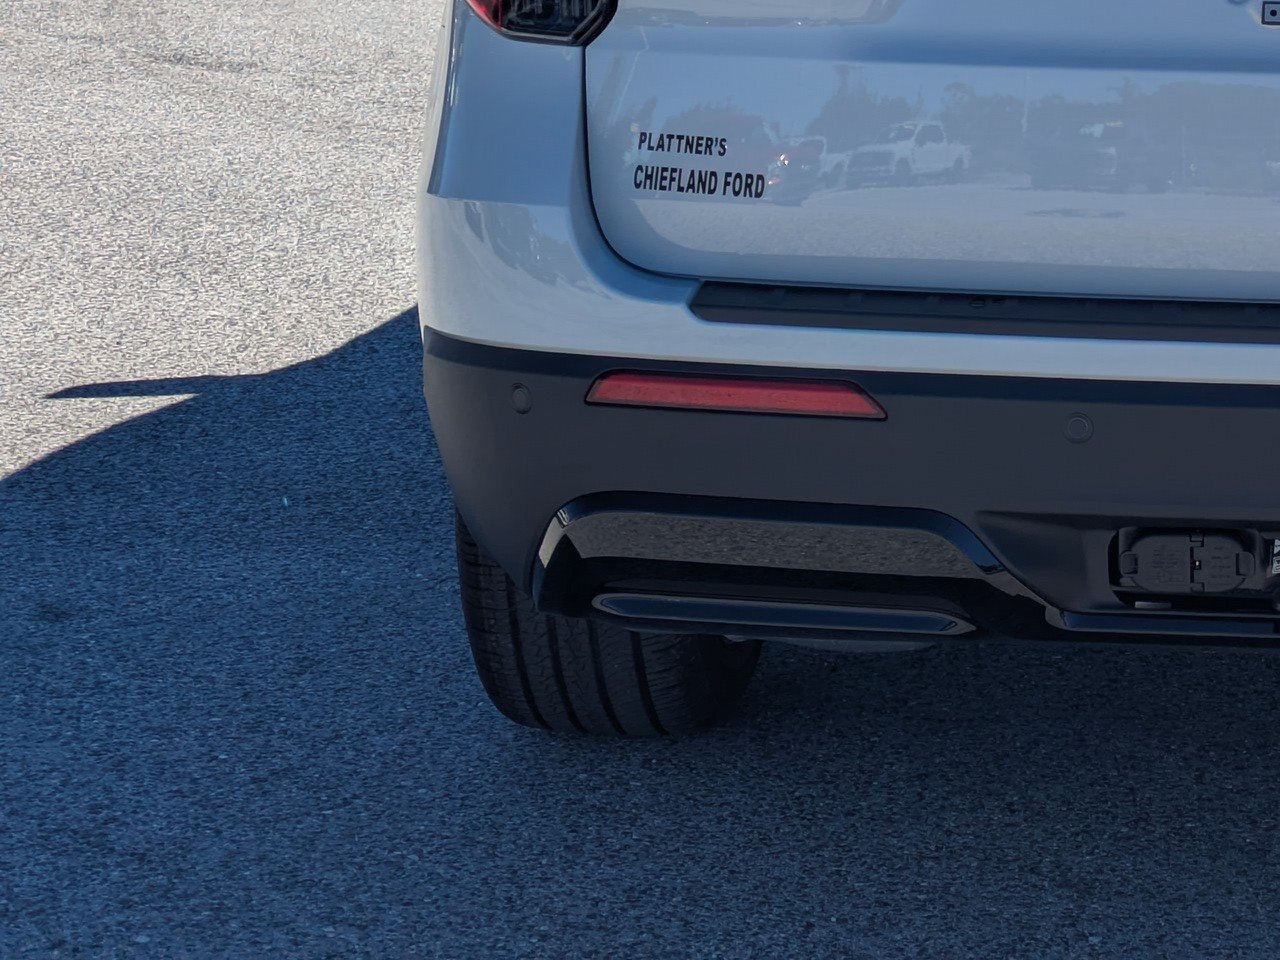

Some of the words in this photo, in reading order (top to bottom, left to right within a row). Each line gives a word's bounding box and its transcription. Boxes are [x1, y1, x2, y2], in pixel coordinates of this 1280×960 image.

[637, 131, 728, 157] PLATTNER'S
[633, 164, 718, 195] CHIEFLAND
[722, 171, 766, 199] FORD
